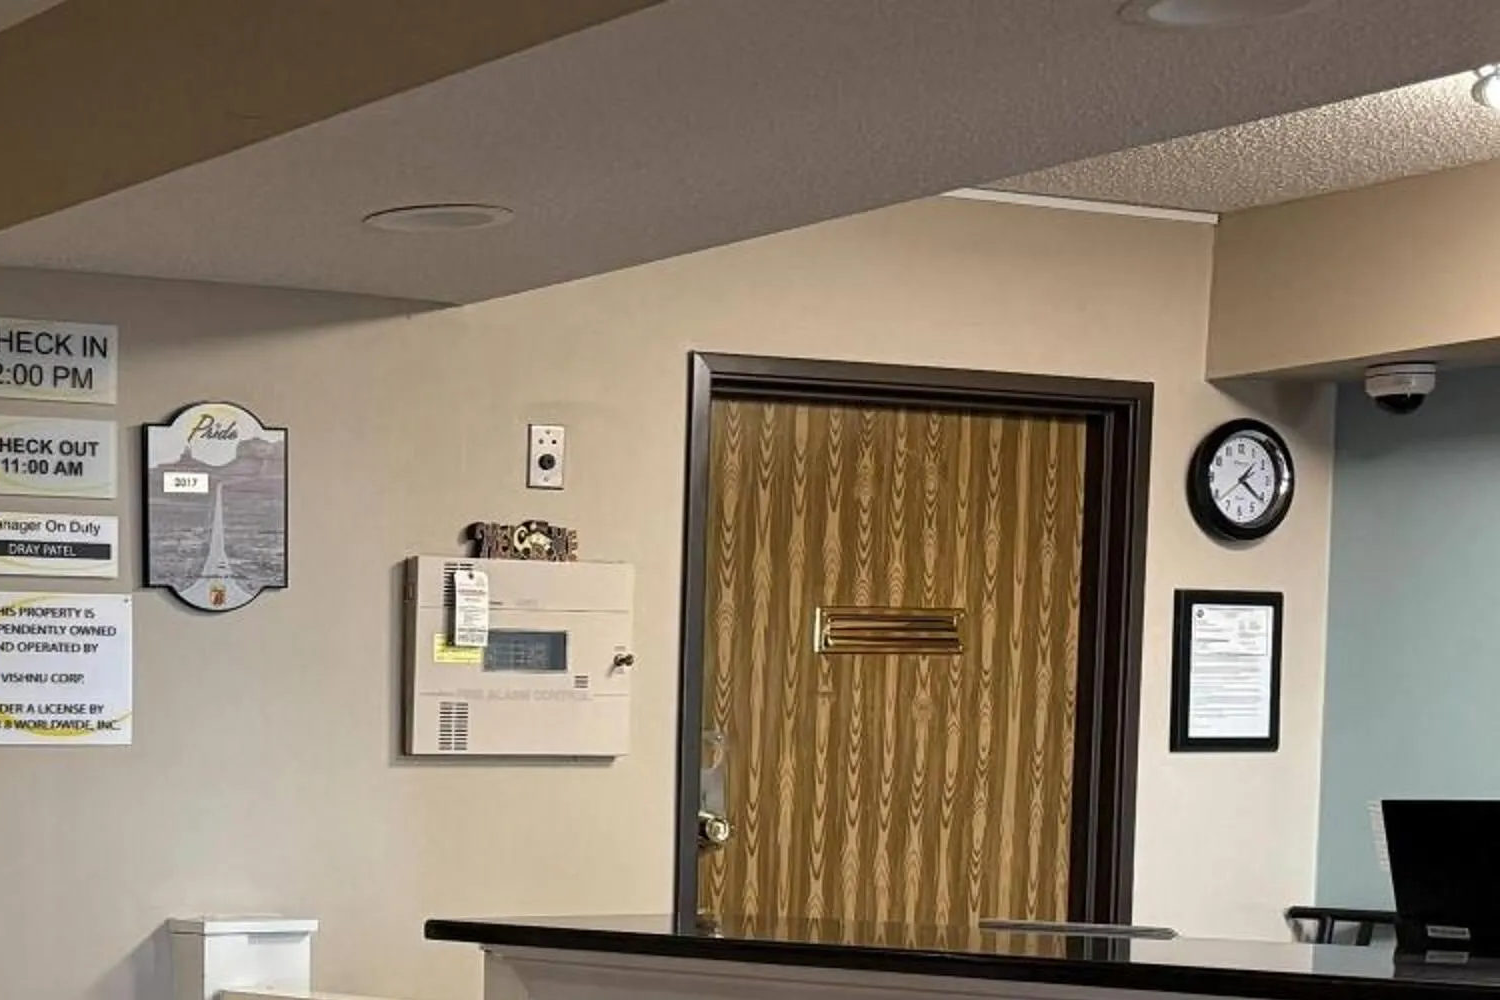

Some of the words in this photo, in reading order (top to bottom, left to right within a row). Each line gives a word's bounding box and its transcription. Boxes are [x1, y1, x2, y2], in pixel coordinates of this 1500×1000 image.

[83, 335, 108, 358] IN
[53, 366, 94, 389] PM
[58, 440, 99, 457] OUT
[1, 458, 49, 475] 11:00
[53, 461, 83, 476] AM
[45, 519, 67, 533] On
[70, 520, 101, 536] Duty
[43, 545, 77, 557] PATEL
[19, 607, 81, 618] PROPERTY
[84, 607, 95, 619] IS
[69, 625, 117, 637] OWNED
[17, 641, 81, 653] OPERATED
[83, 643, 99, 653] BY
[0, 672, 48, 683] VISHNU
[26, 703, 35, 714] A
[37, 703, 87, 714] LICENSE
[89, 704, 104, 714] BY
